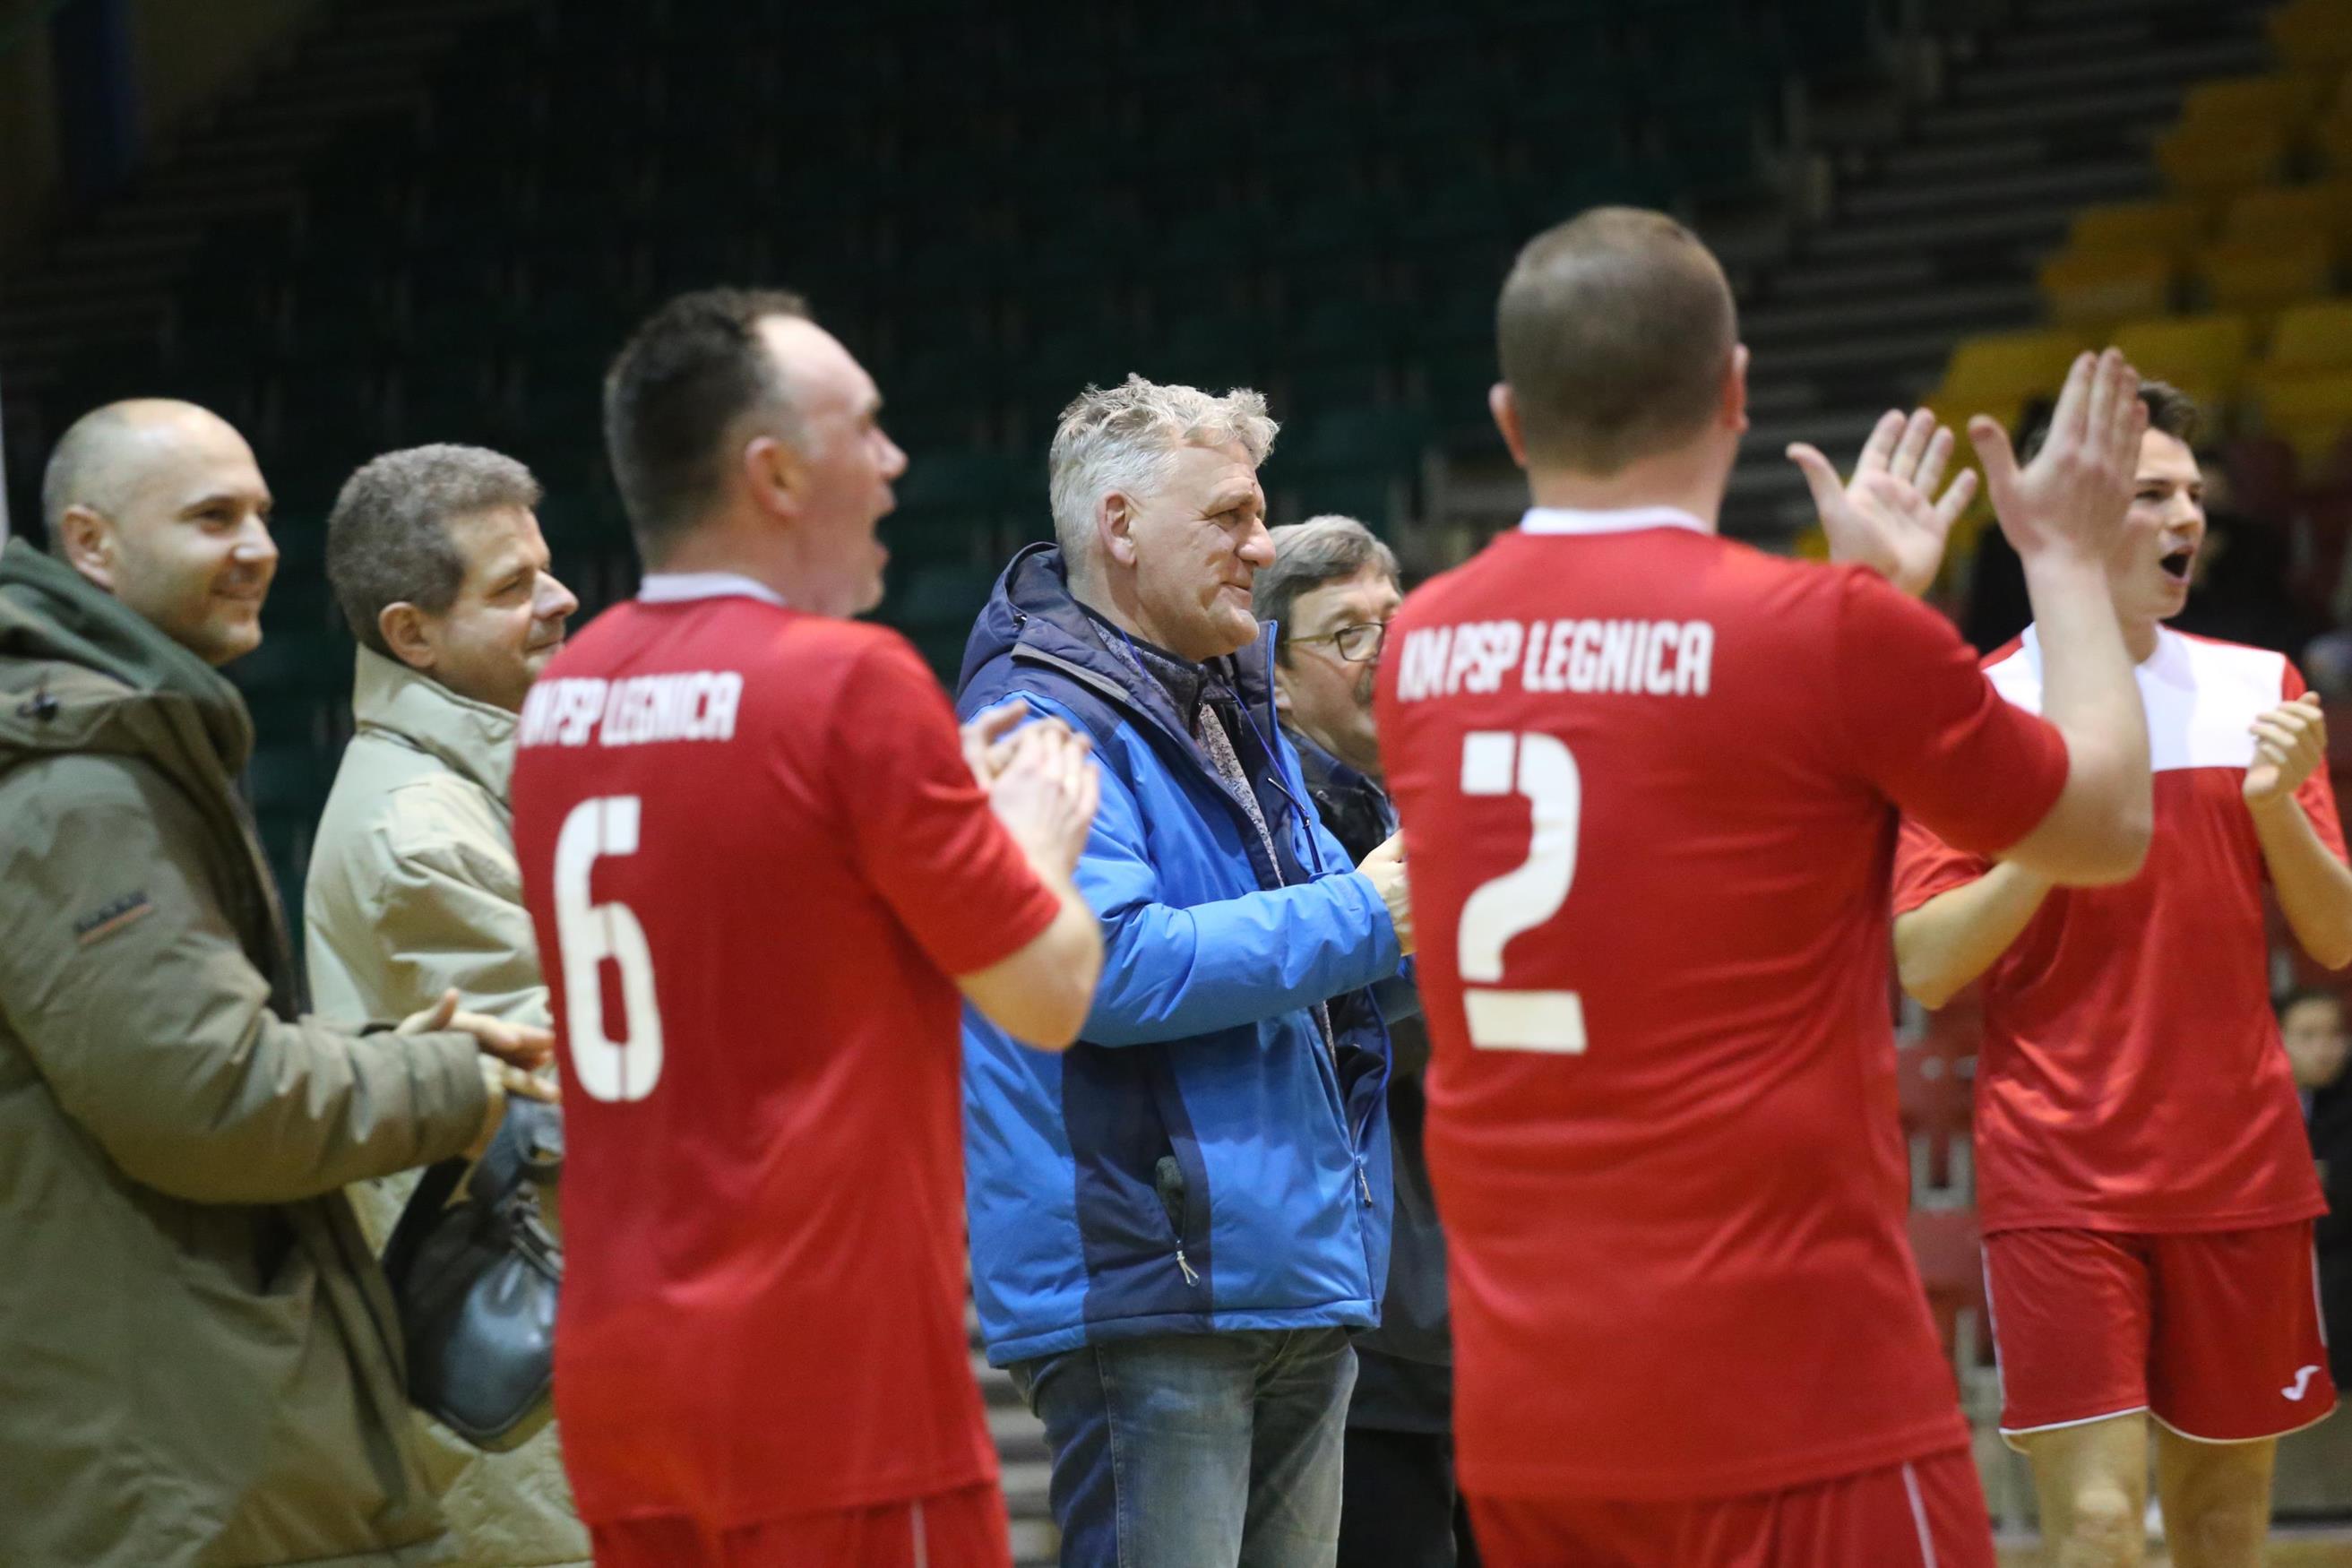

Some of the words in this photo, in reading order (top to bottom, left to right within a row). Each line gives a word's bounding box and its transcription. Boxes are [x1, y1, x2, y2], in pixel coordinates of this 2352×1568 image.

[1445, 620, 1524, 694] PSP
[1521, 618, 1715, 695] LEGNICA
[553, 795, 665, 1102] 6
[1457, 730, 1589, 1055] 2
